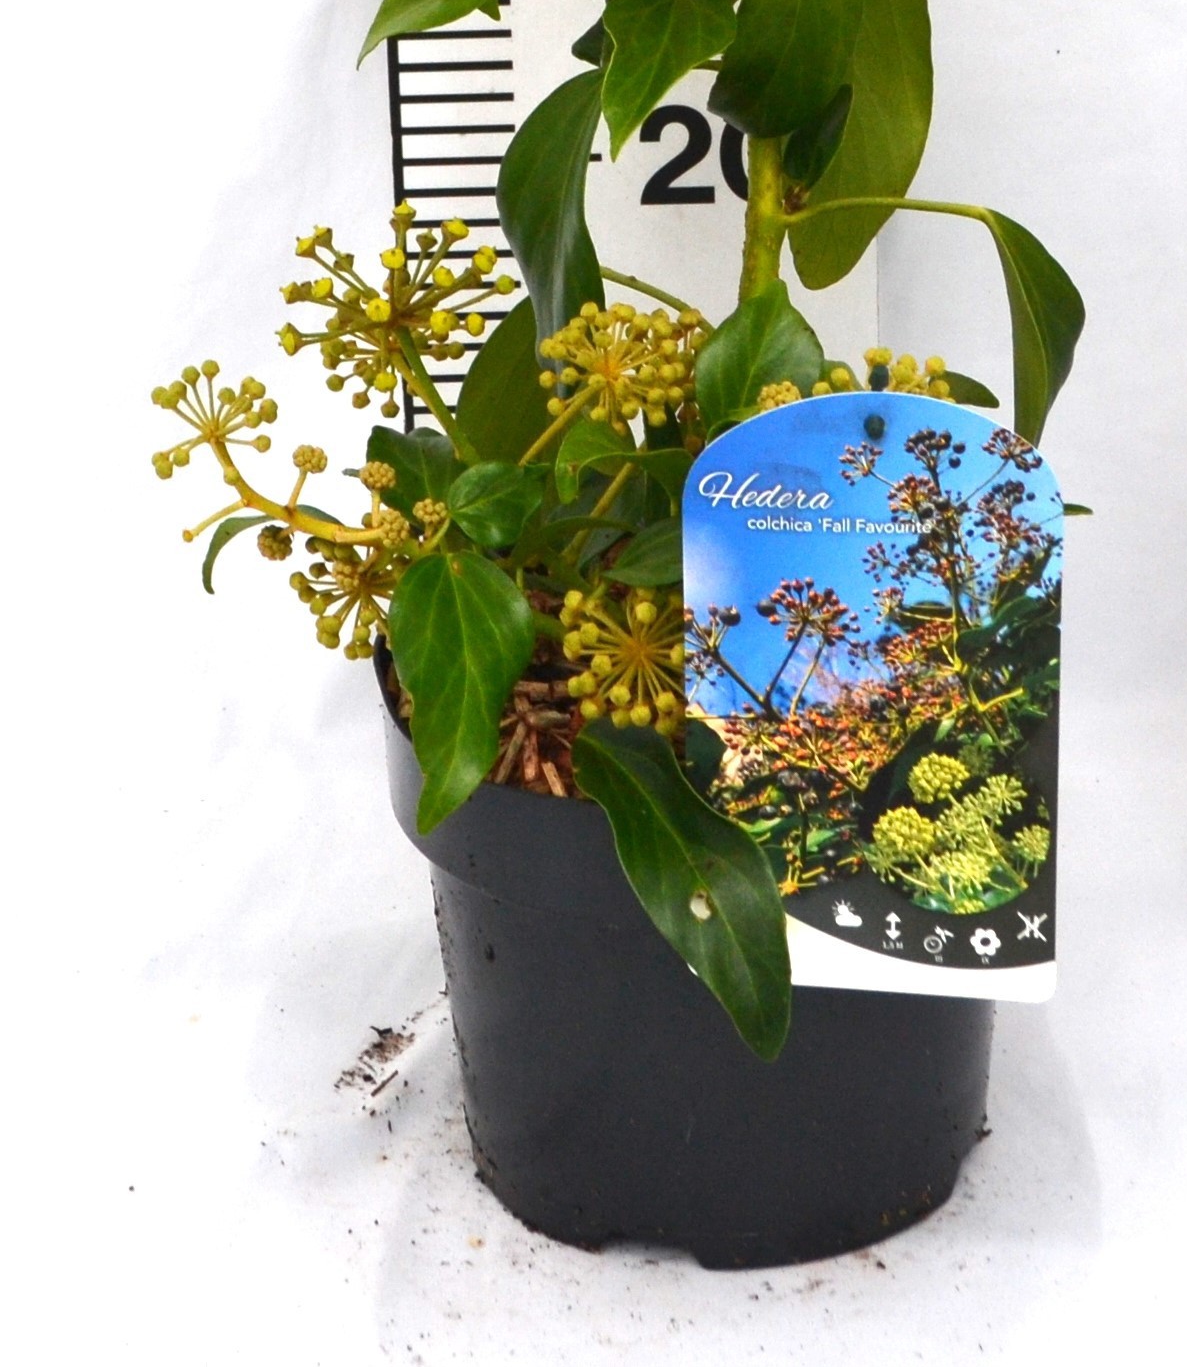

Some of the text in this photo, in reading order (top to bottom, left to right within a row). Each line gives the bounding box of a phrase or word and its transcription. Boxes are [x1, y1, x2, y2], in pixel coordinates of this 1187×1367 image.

[697, 471, 834, 510] Hedera
[747, 516, 813, 533] colchica
[818, 518, 851, 533] 'Fall
